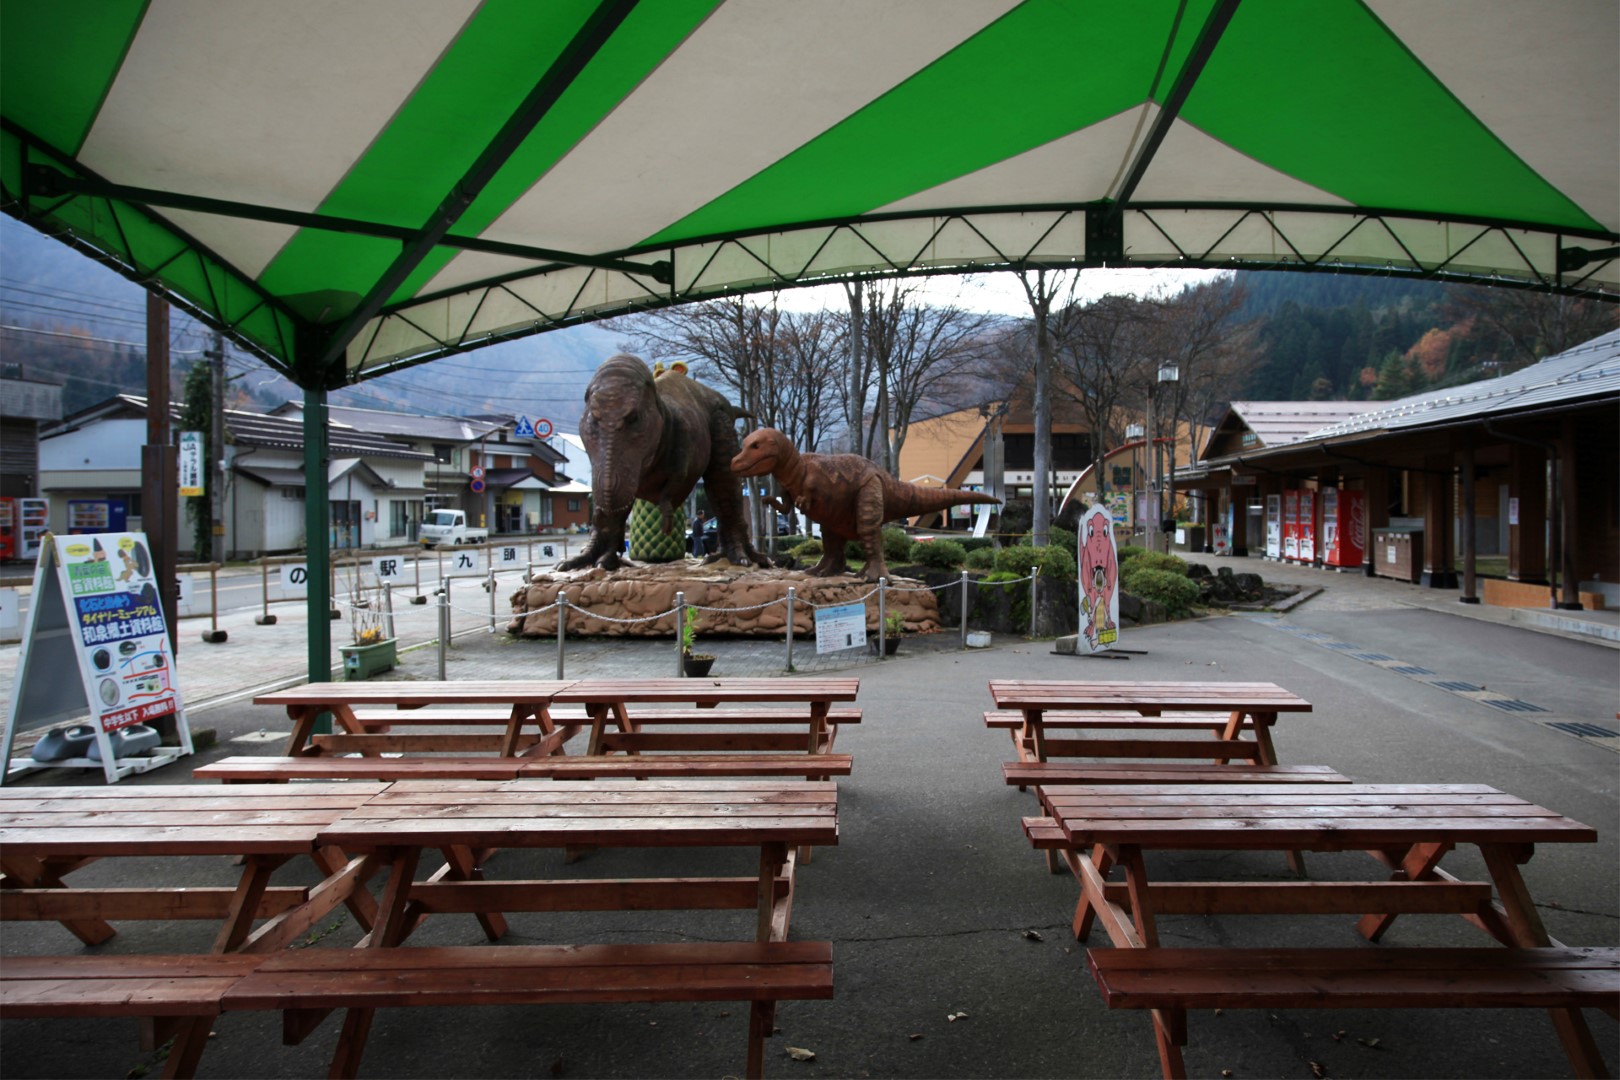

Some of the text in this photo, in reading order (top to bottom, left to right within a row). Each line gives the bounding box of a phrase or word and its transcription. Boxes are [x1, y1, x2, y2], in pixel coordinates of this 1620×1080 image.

[538, 424, 548, 433] 40
[290, 545, 554, 584] の 駅 九 頭 竜
[82, 615, 164, 645] 和泉郷土資料館
